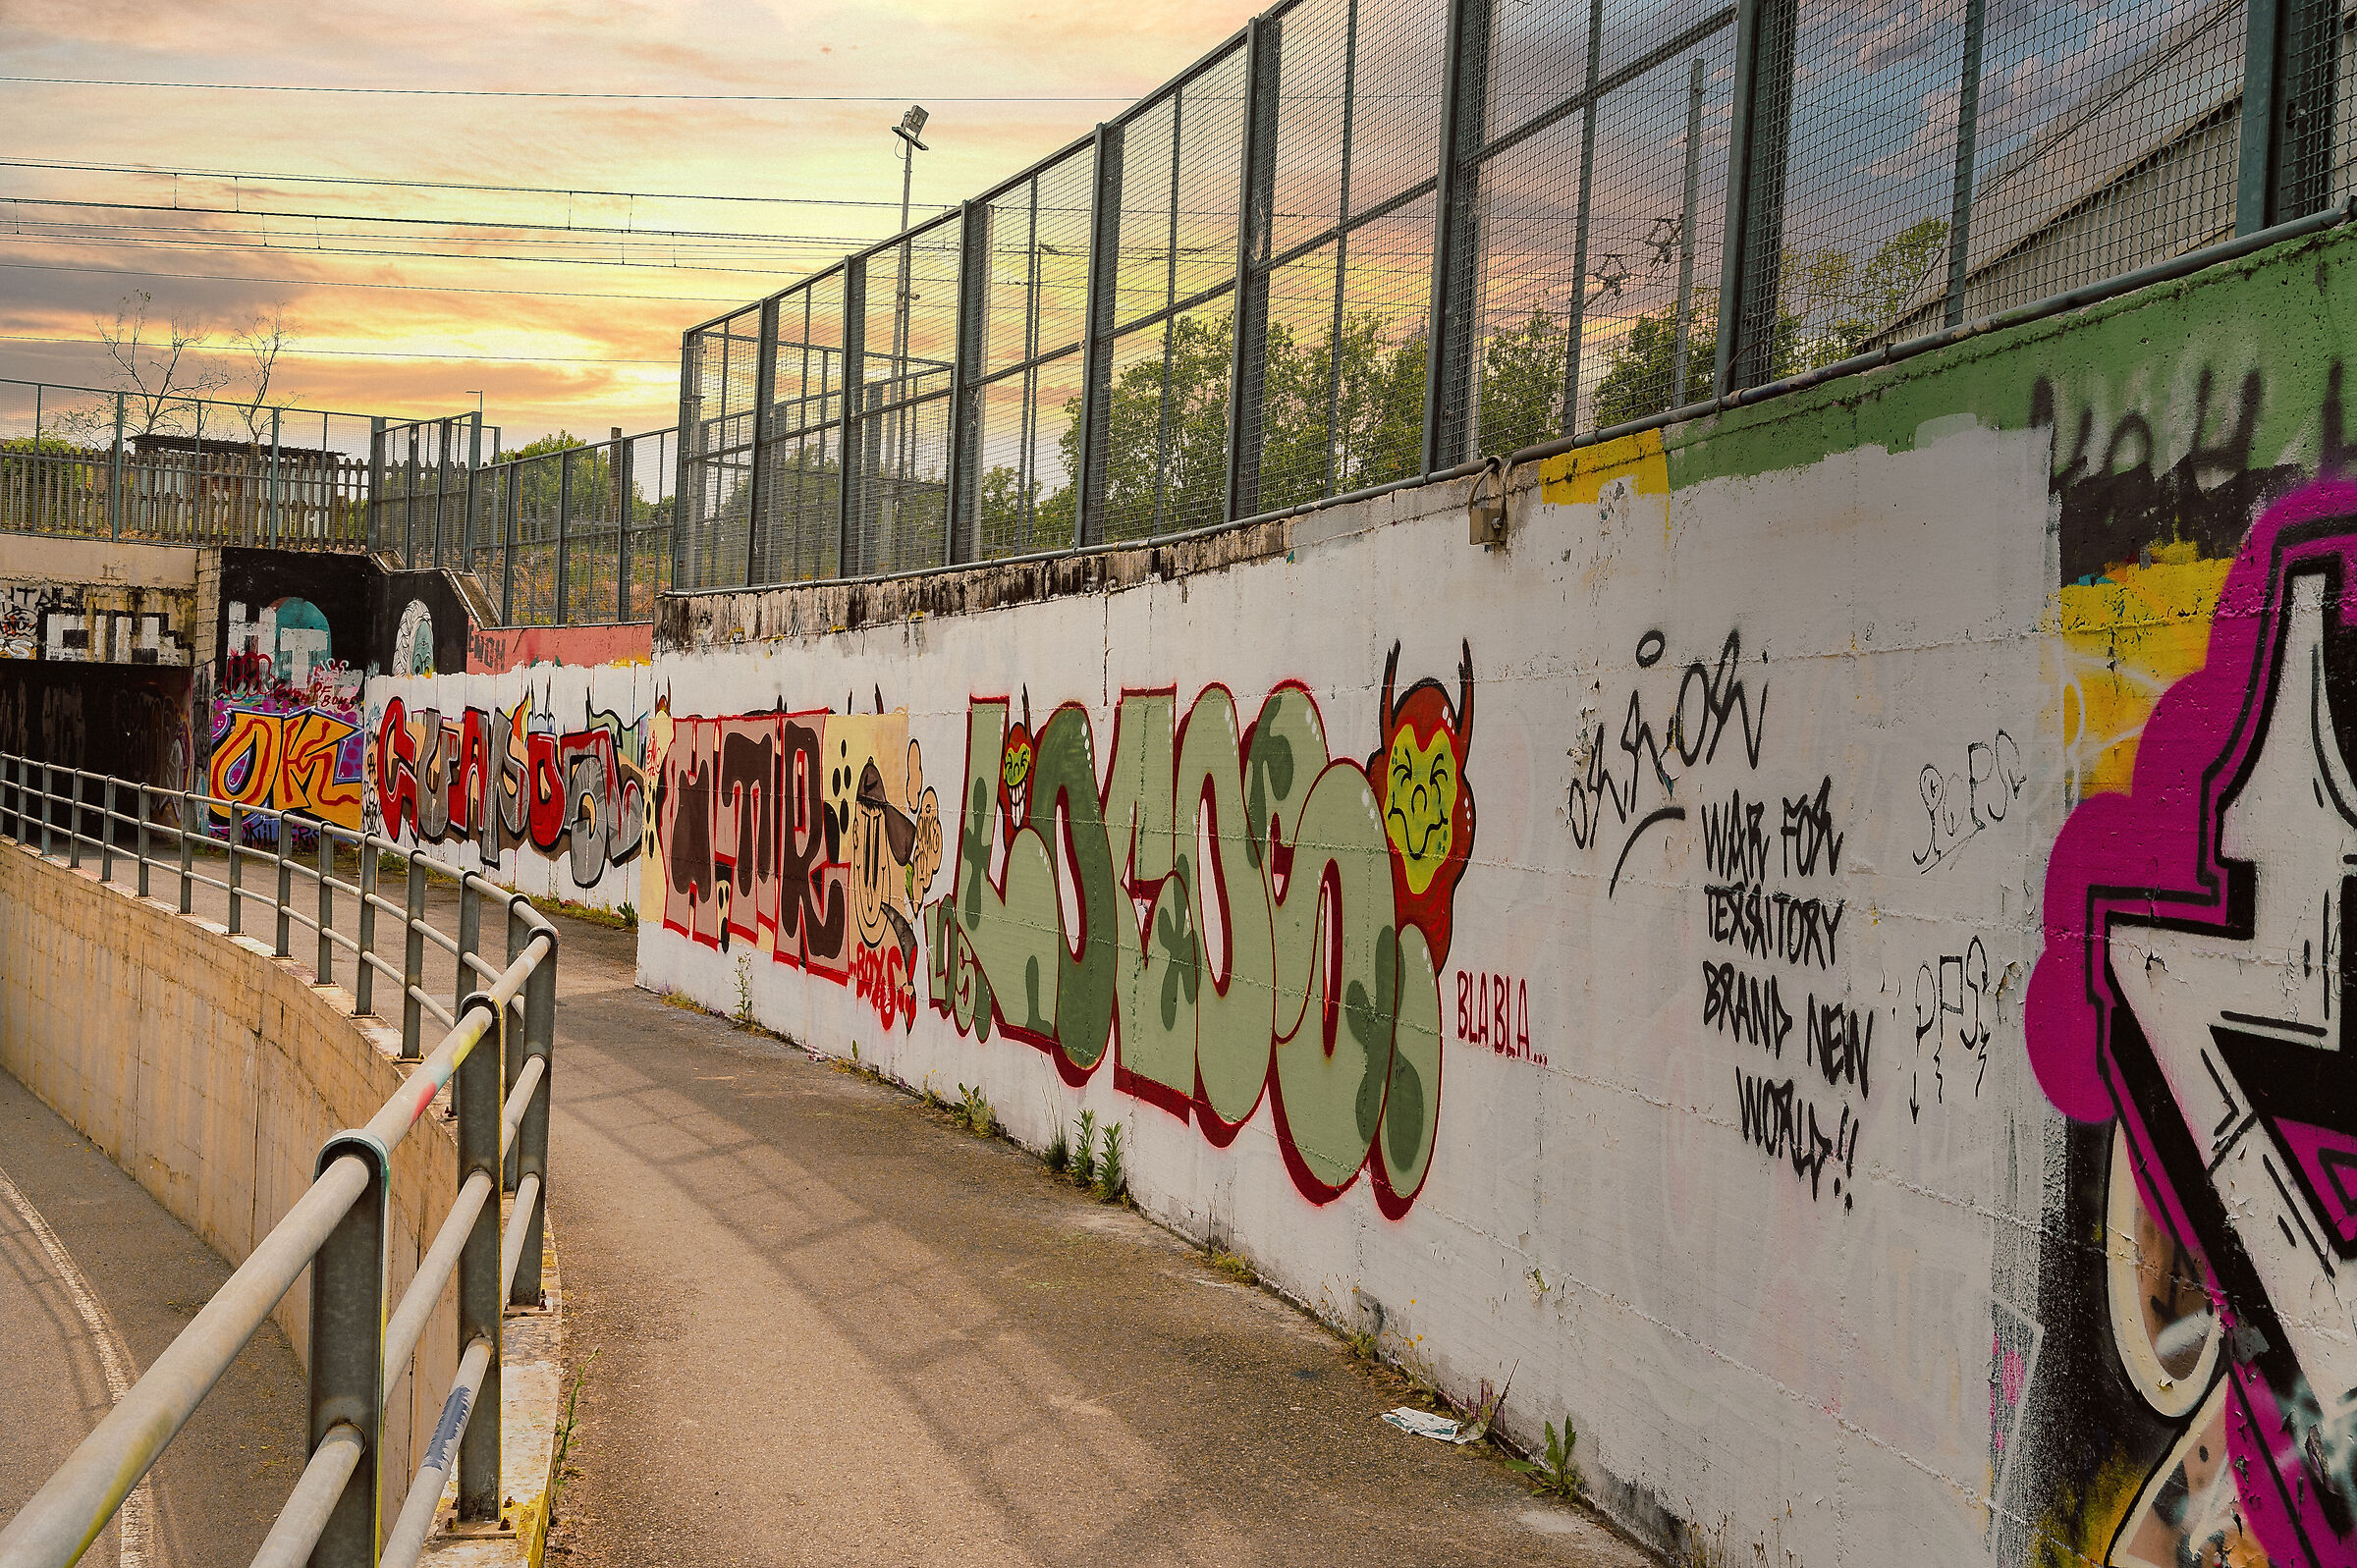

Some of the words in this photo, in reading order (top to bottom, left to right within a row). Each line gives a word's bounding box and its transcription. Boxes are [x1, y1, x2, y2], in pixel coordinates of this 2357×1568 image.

[209, 709, 362, 832] OK
[1701, 788, 1771, 887] WAR
[1781, 775, 1844, 879] FOR
[1703, 881, 1846, 971] TERRITORY
[1456, 970, 1489, 1048] BLA
[1702, 960, 1793, 1060] BRAND
[1807, 992, 1874, 1102] NEW
